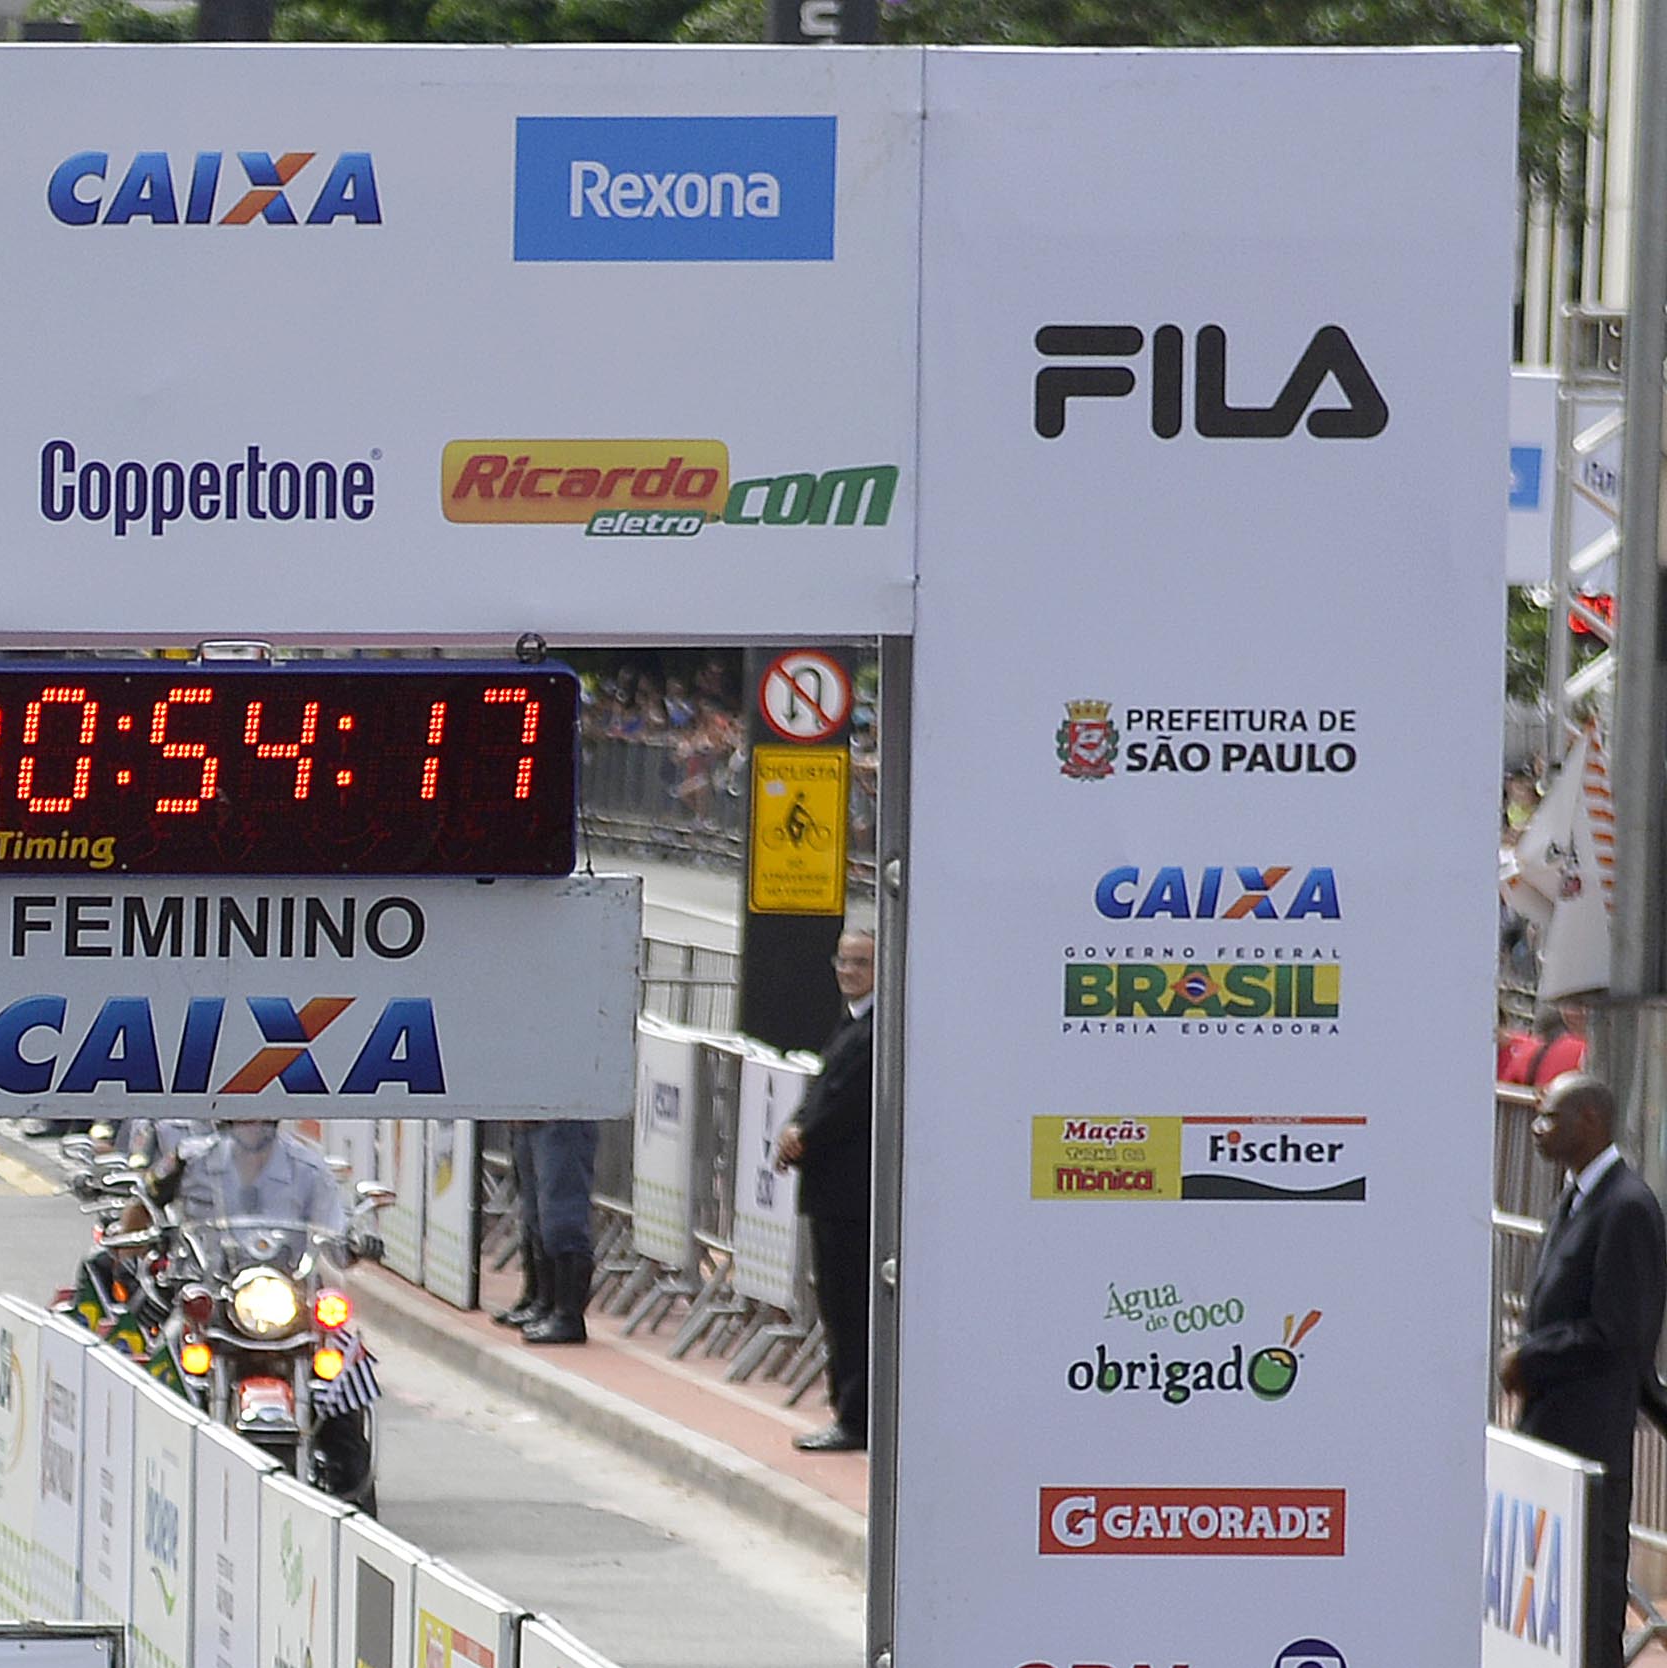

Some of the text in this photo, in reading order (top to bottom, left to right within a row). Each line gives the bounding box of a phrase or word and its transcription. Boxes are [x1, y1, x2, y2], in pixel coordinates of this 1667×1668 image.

[47, 152, 382, 225] CAIXA
[570, 161, 780, 218] Rexona
[1034, 324, 1389, 440] FILA
[452, 456, 719, 498] Ricardo
[593, 514, 701, 535] eletro
[1126, 709, 1356, 732] PREFEITURA DE
[1126, 736, 1357, 772] SÃO PAULO
[1094, 866, 1341, 920] CAIXA
[11, 896, 426, 959] FEMININO
[1065, 948, 1341, 958] GOVERNO FEDERAL
[1064, 963, 1340, 1018] BRASIL
[1063, 1020, 1340, 1034] PÁTRIA EDUCADORA
[1063, 1120, 1146, 1145] Maçãs
[1209, 1130, 1344, 1163] Fischer
[1056, 1167, 1153, 1192] Mônica
[1103, 1283, 1181, 1321] Água
[1145, 1298, 1244, 1335] de coco
[1103, 1505, 1330, 1540] GATORADE
